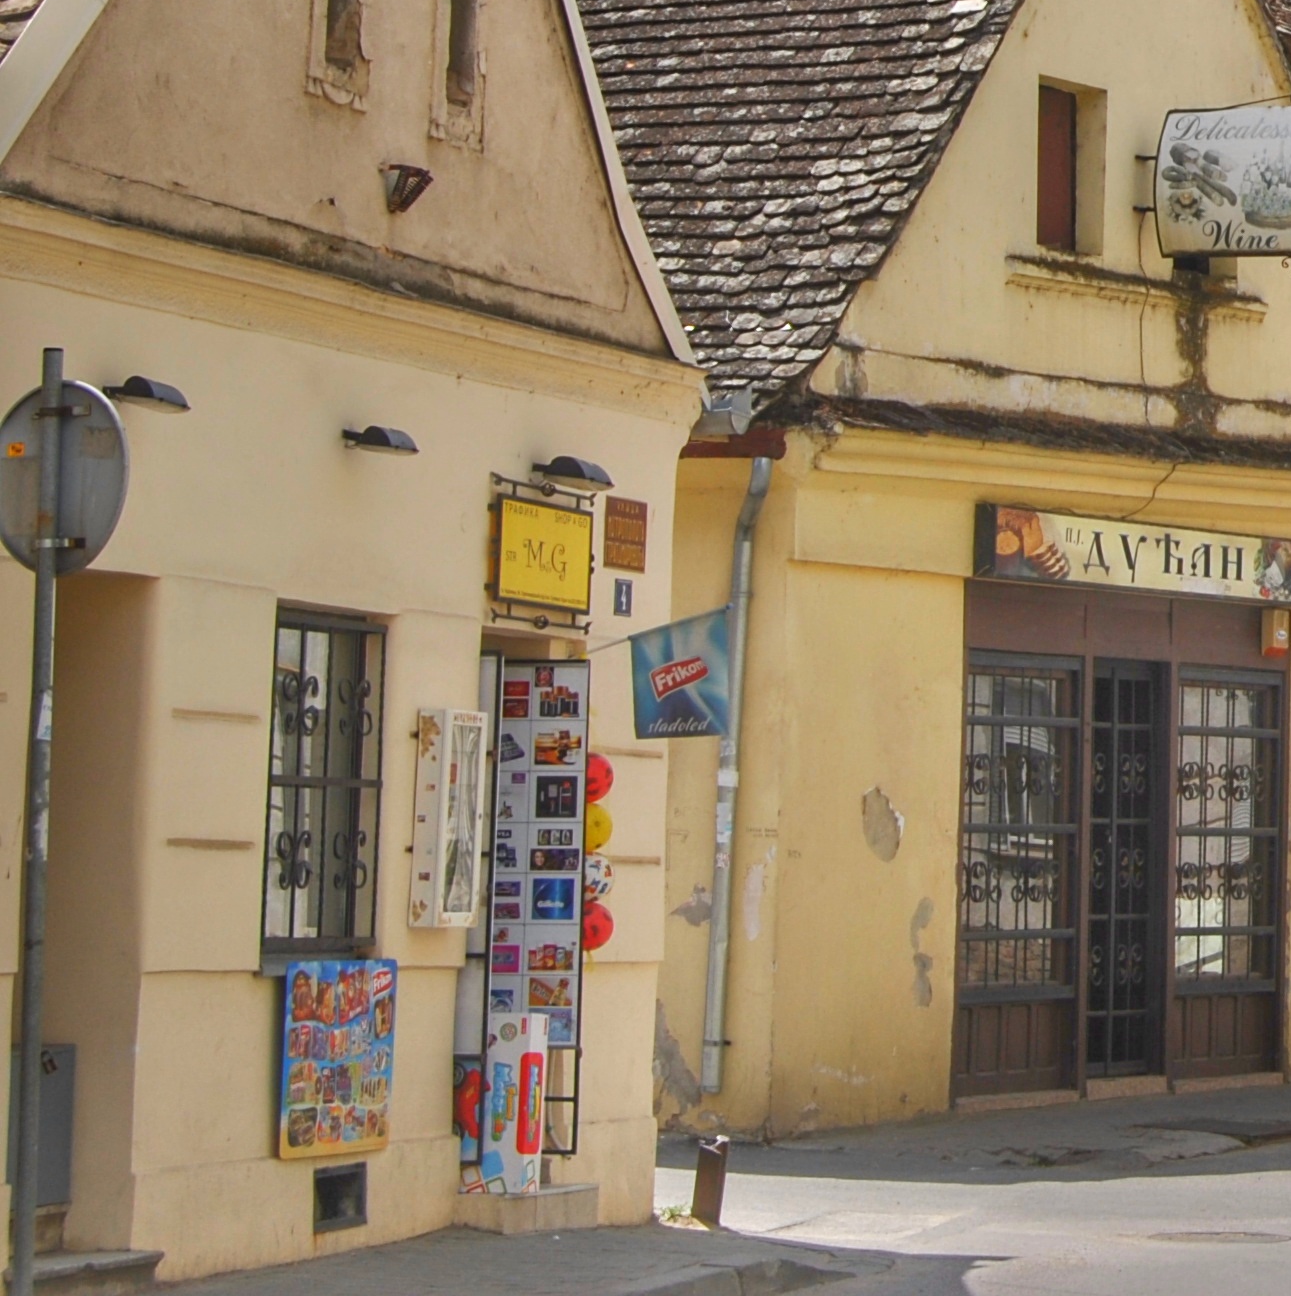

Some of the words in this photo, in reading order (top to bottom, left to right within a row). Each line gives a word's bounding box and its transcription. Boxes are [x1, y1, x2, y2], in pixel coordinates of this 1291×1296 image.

[1202, 218, 1280, 250] Wine
[504, 502, 539, 519] ТРАФИКА
[654, 660, 705, 692] Frikom
[647, 716, 713, 734] sladoled
